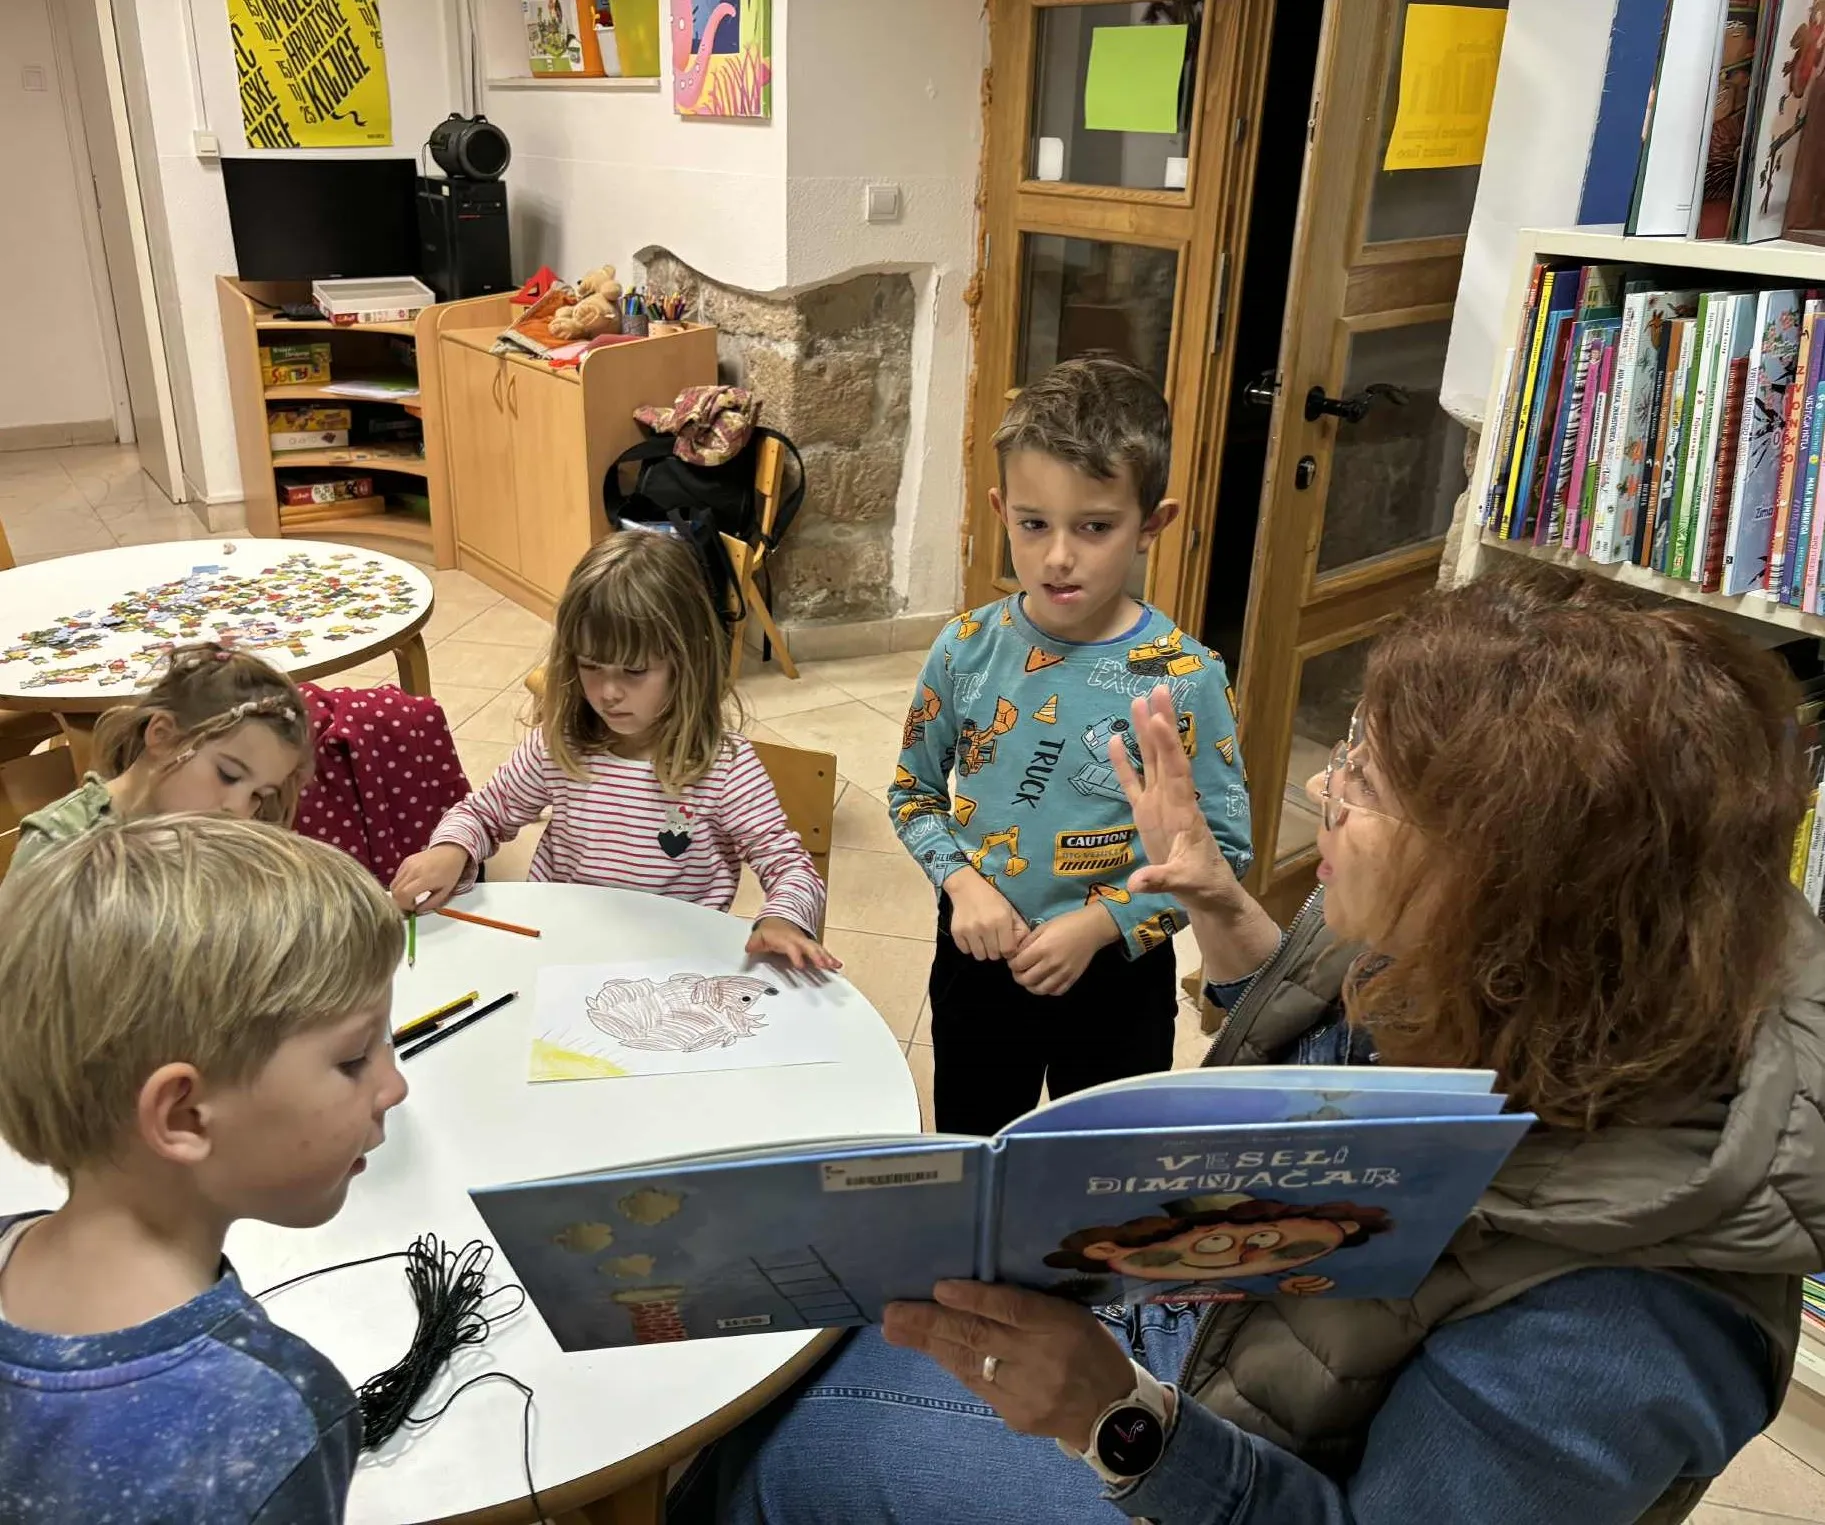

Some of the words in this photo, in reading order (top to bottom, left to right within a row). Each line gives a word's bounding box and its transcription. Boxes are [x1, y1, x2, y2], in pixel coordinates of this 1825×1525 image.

[282, 0, 348, 75] HRVATSKE
[301, 26, 371, 122] KNJIGE
[1011, 738, 1066, 809] TRUCK
[1066, 831, 1128, 847] CAUTION
[1086, 1167, 1401, 1195] DIMNJAČAR
[1156, 1146, 1349, 1171] VESELI
